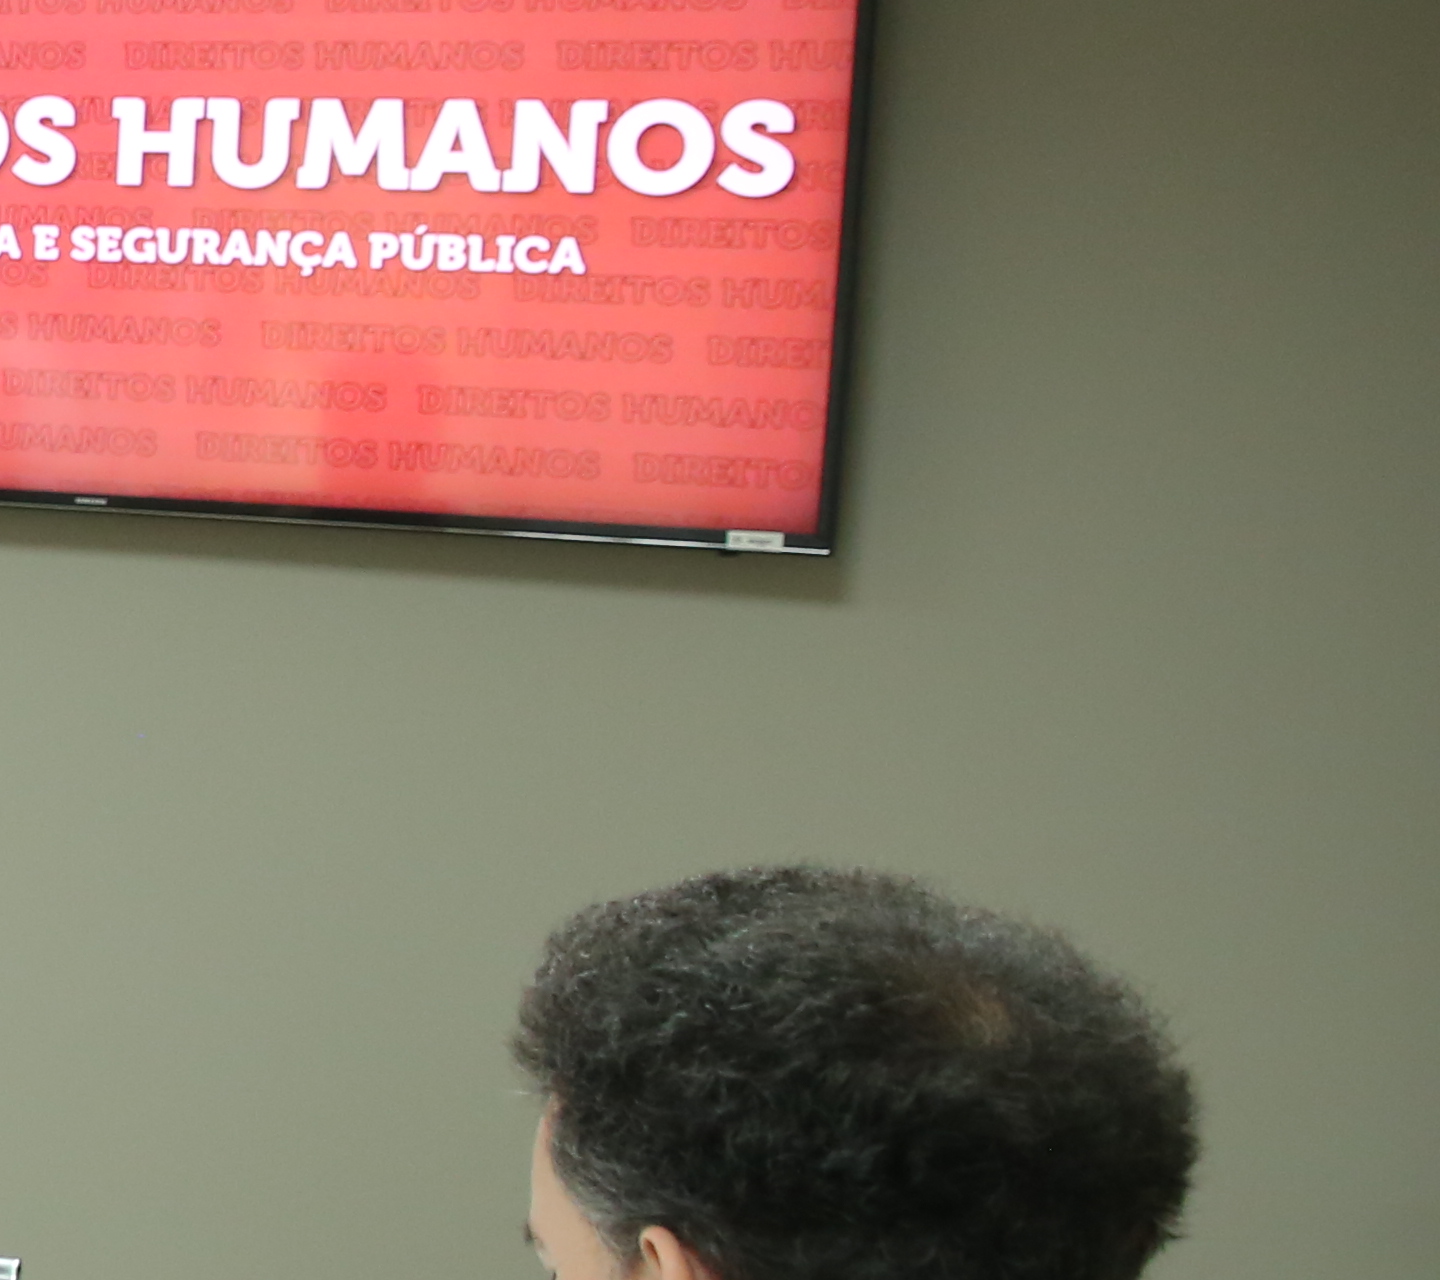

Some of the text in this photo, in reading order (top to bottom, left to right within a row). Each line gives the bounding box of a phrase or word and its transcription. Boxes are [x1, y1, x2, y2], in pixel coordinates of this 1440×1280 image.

[125, 40, 525, 71] DIREITOS HUMANOS
[111, 97, 796, 198] HUMANOS
[33, 224, 60, 261] E
[71, 224, 357, 278] SEGURANÇA
[370, 224, 587, 275] PÚBLICA
[29, 312, 221, 349] HUMANOS
[262, 320, 672, 363] DIREITOS HUMANOS
[3, 368, 387, 412] DIREITOS HUMANOS
[196, 431, 600, 480] DIREITOS HUMANOS
